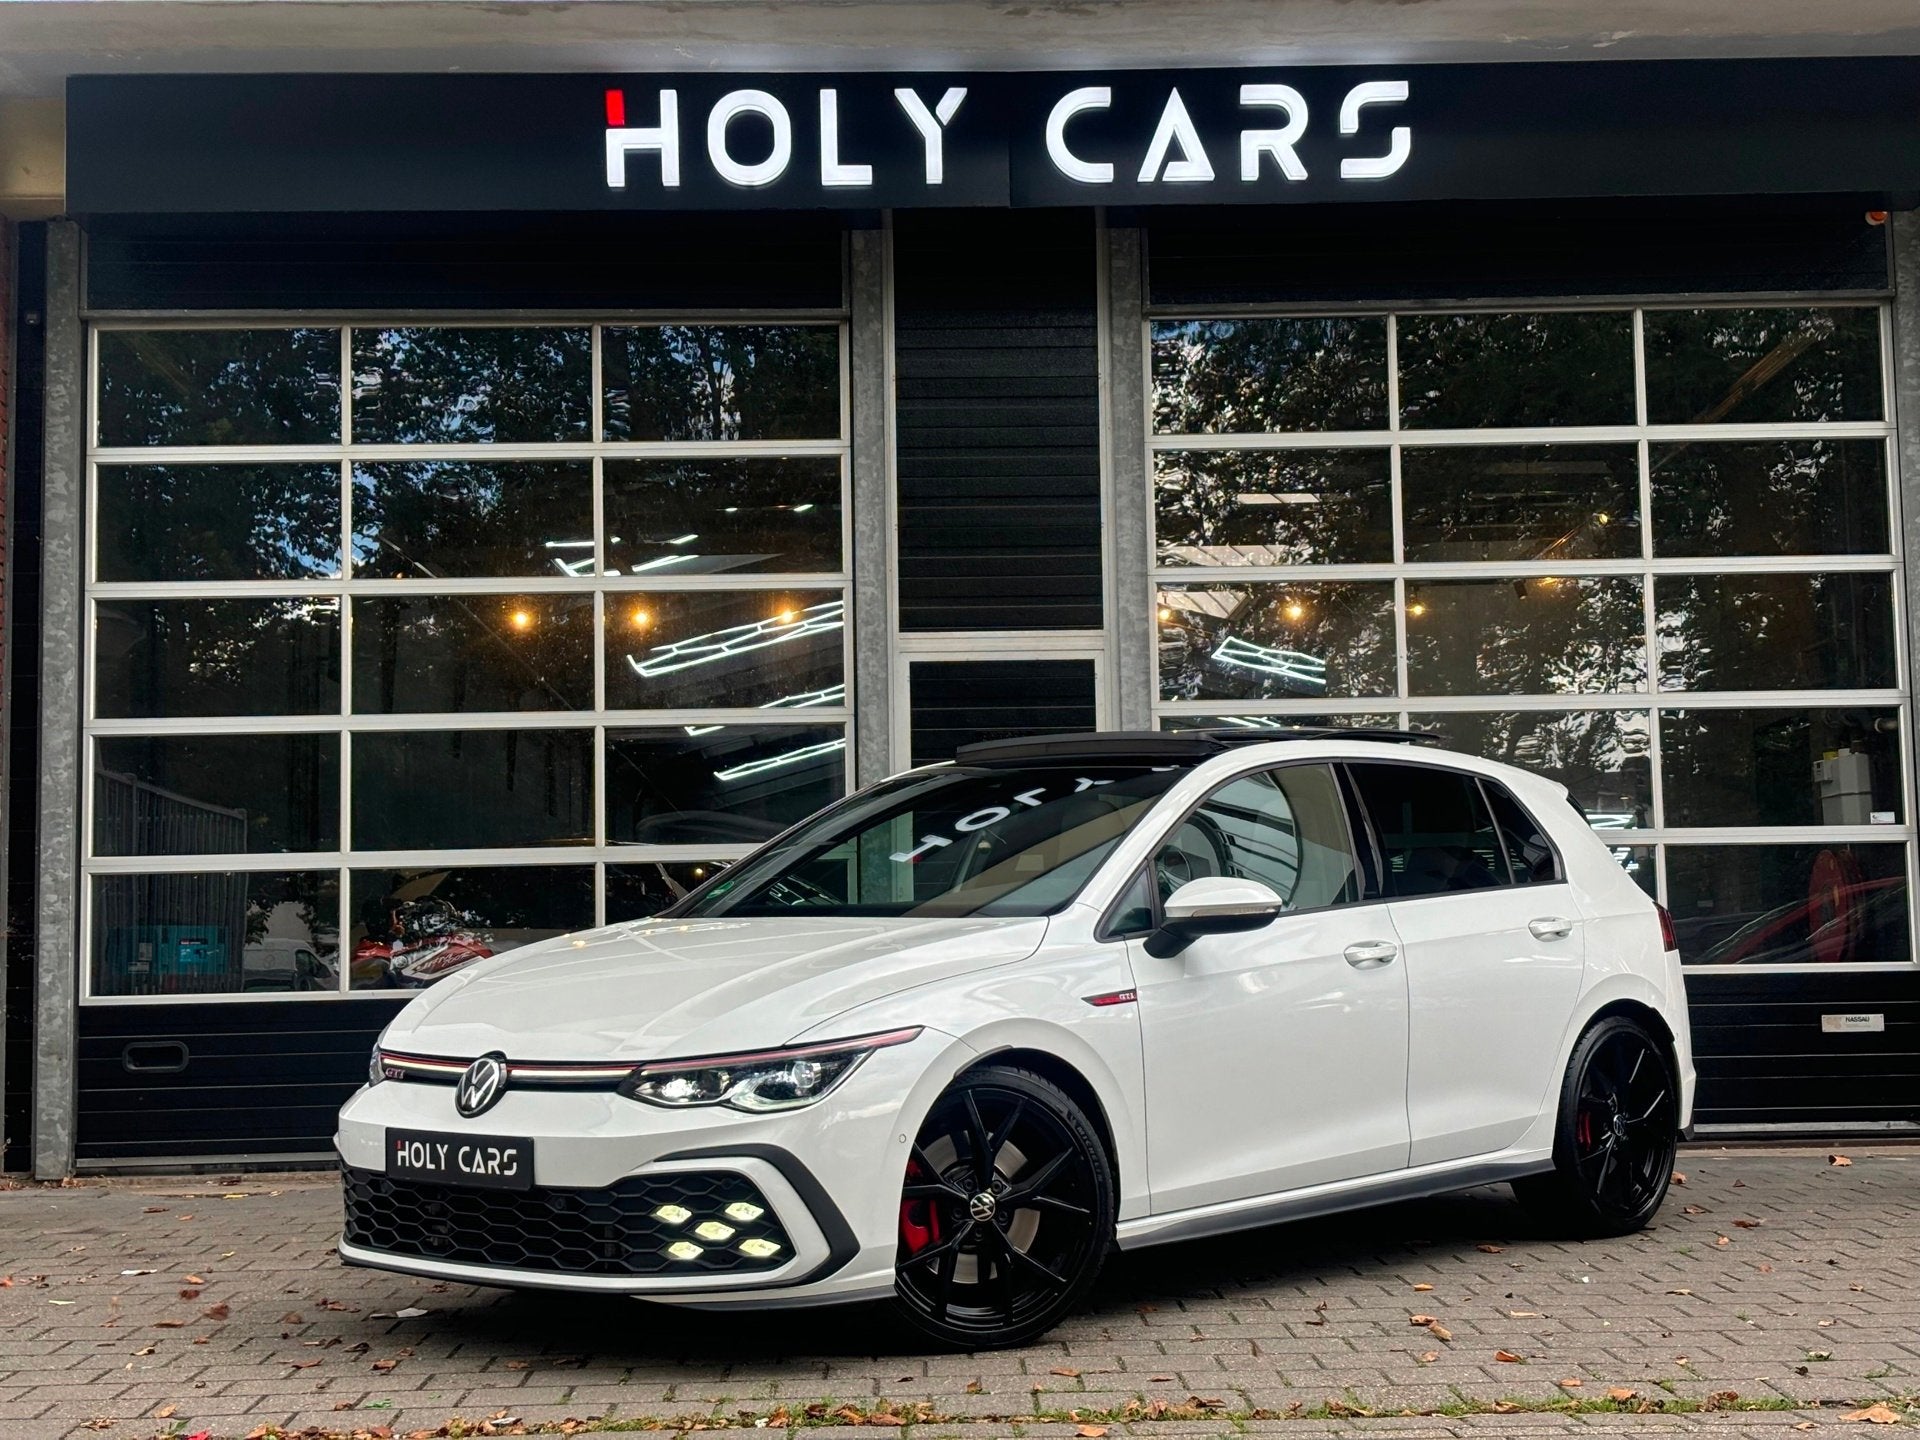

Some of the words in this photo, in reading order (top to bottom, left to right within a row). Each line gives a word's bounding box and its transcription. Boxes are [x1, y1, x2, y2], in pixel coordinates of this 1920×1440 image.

[605, 88, 968, 188] HOLY
[1045, 80, 1412, 184] CARS
[385, 1067, 405, 1080] GTI
[396, 1139, 449, 1171] HOLY
[457, 1145, 518, 1176] CARS
